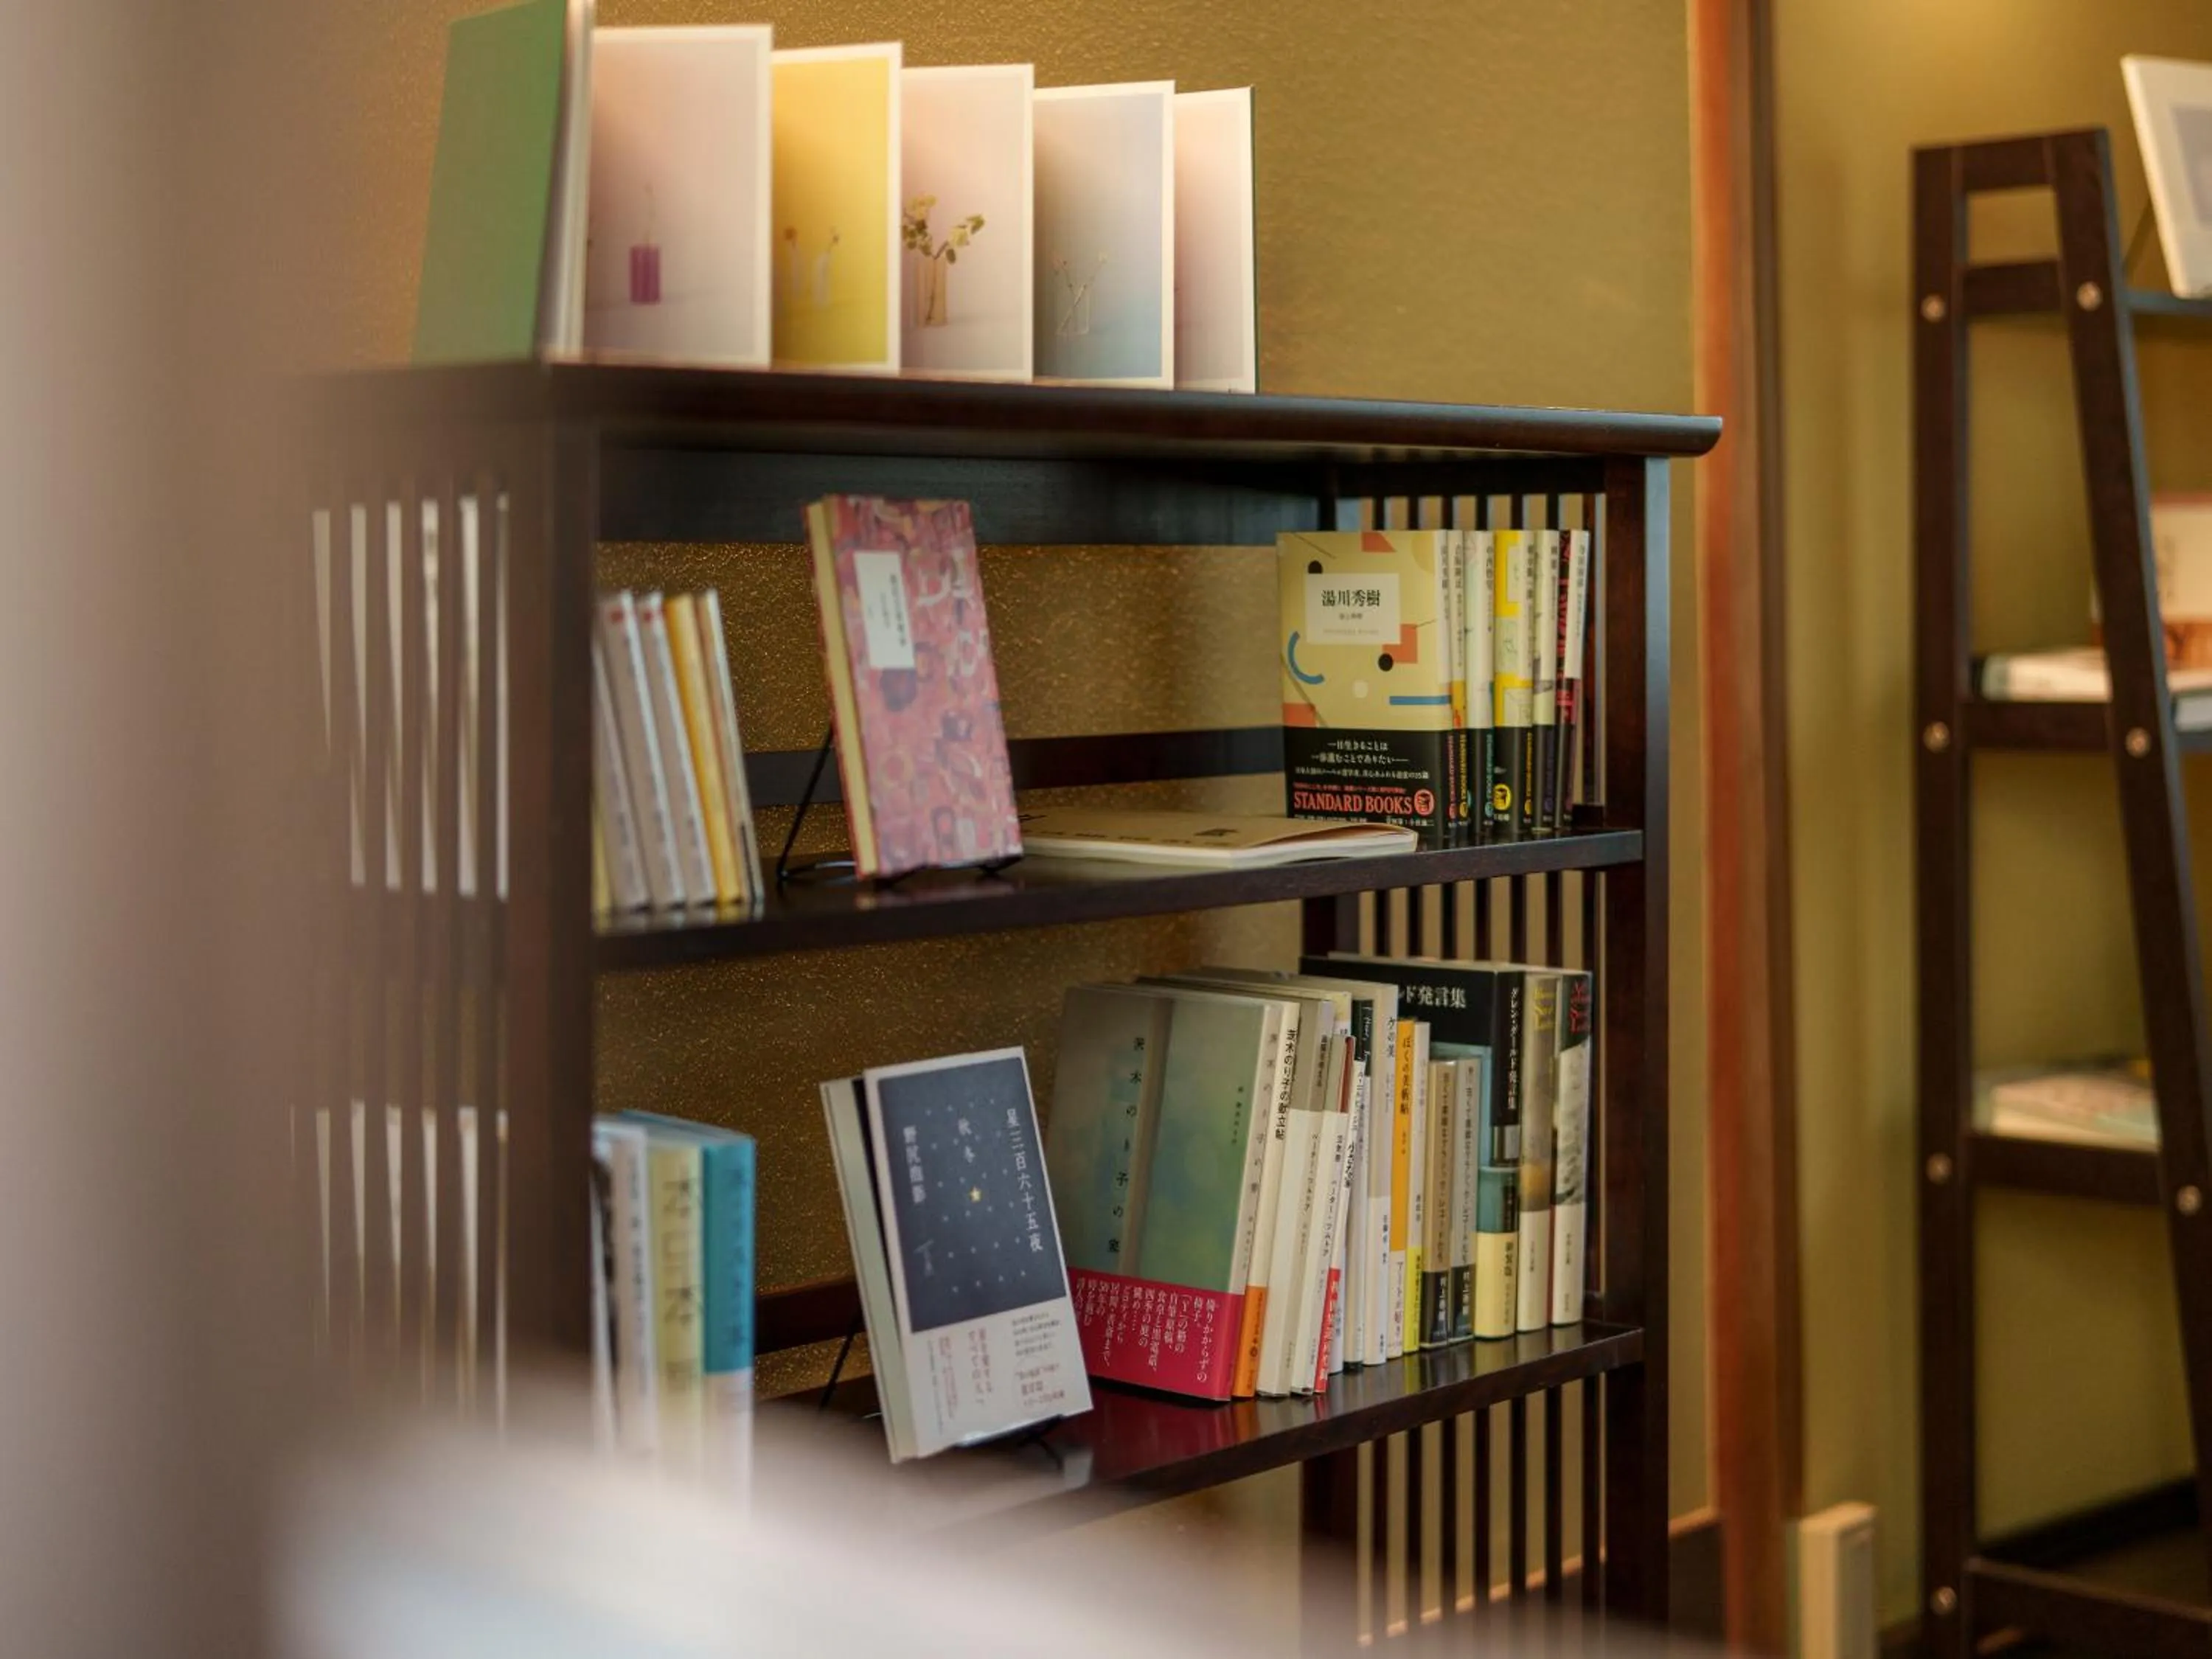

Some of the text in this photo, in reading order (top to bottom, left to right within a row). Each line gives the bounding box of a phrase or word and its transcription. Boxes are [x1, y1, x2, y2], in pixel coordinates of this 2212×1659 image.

[1321, 589, 1380, 607] 湯川秀樹
[1294, 791, 1413, 815] STANDARD BOOKS
[1401, 986, 1467, 1009] ド発言集
[1007, 1108, 1043, 1252] 星三百六十五夜
